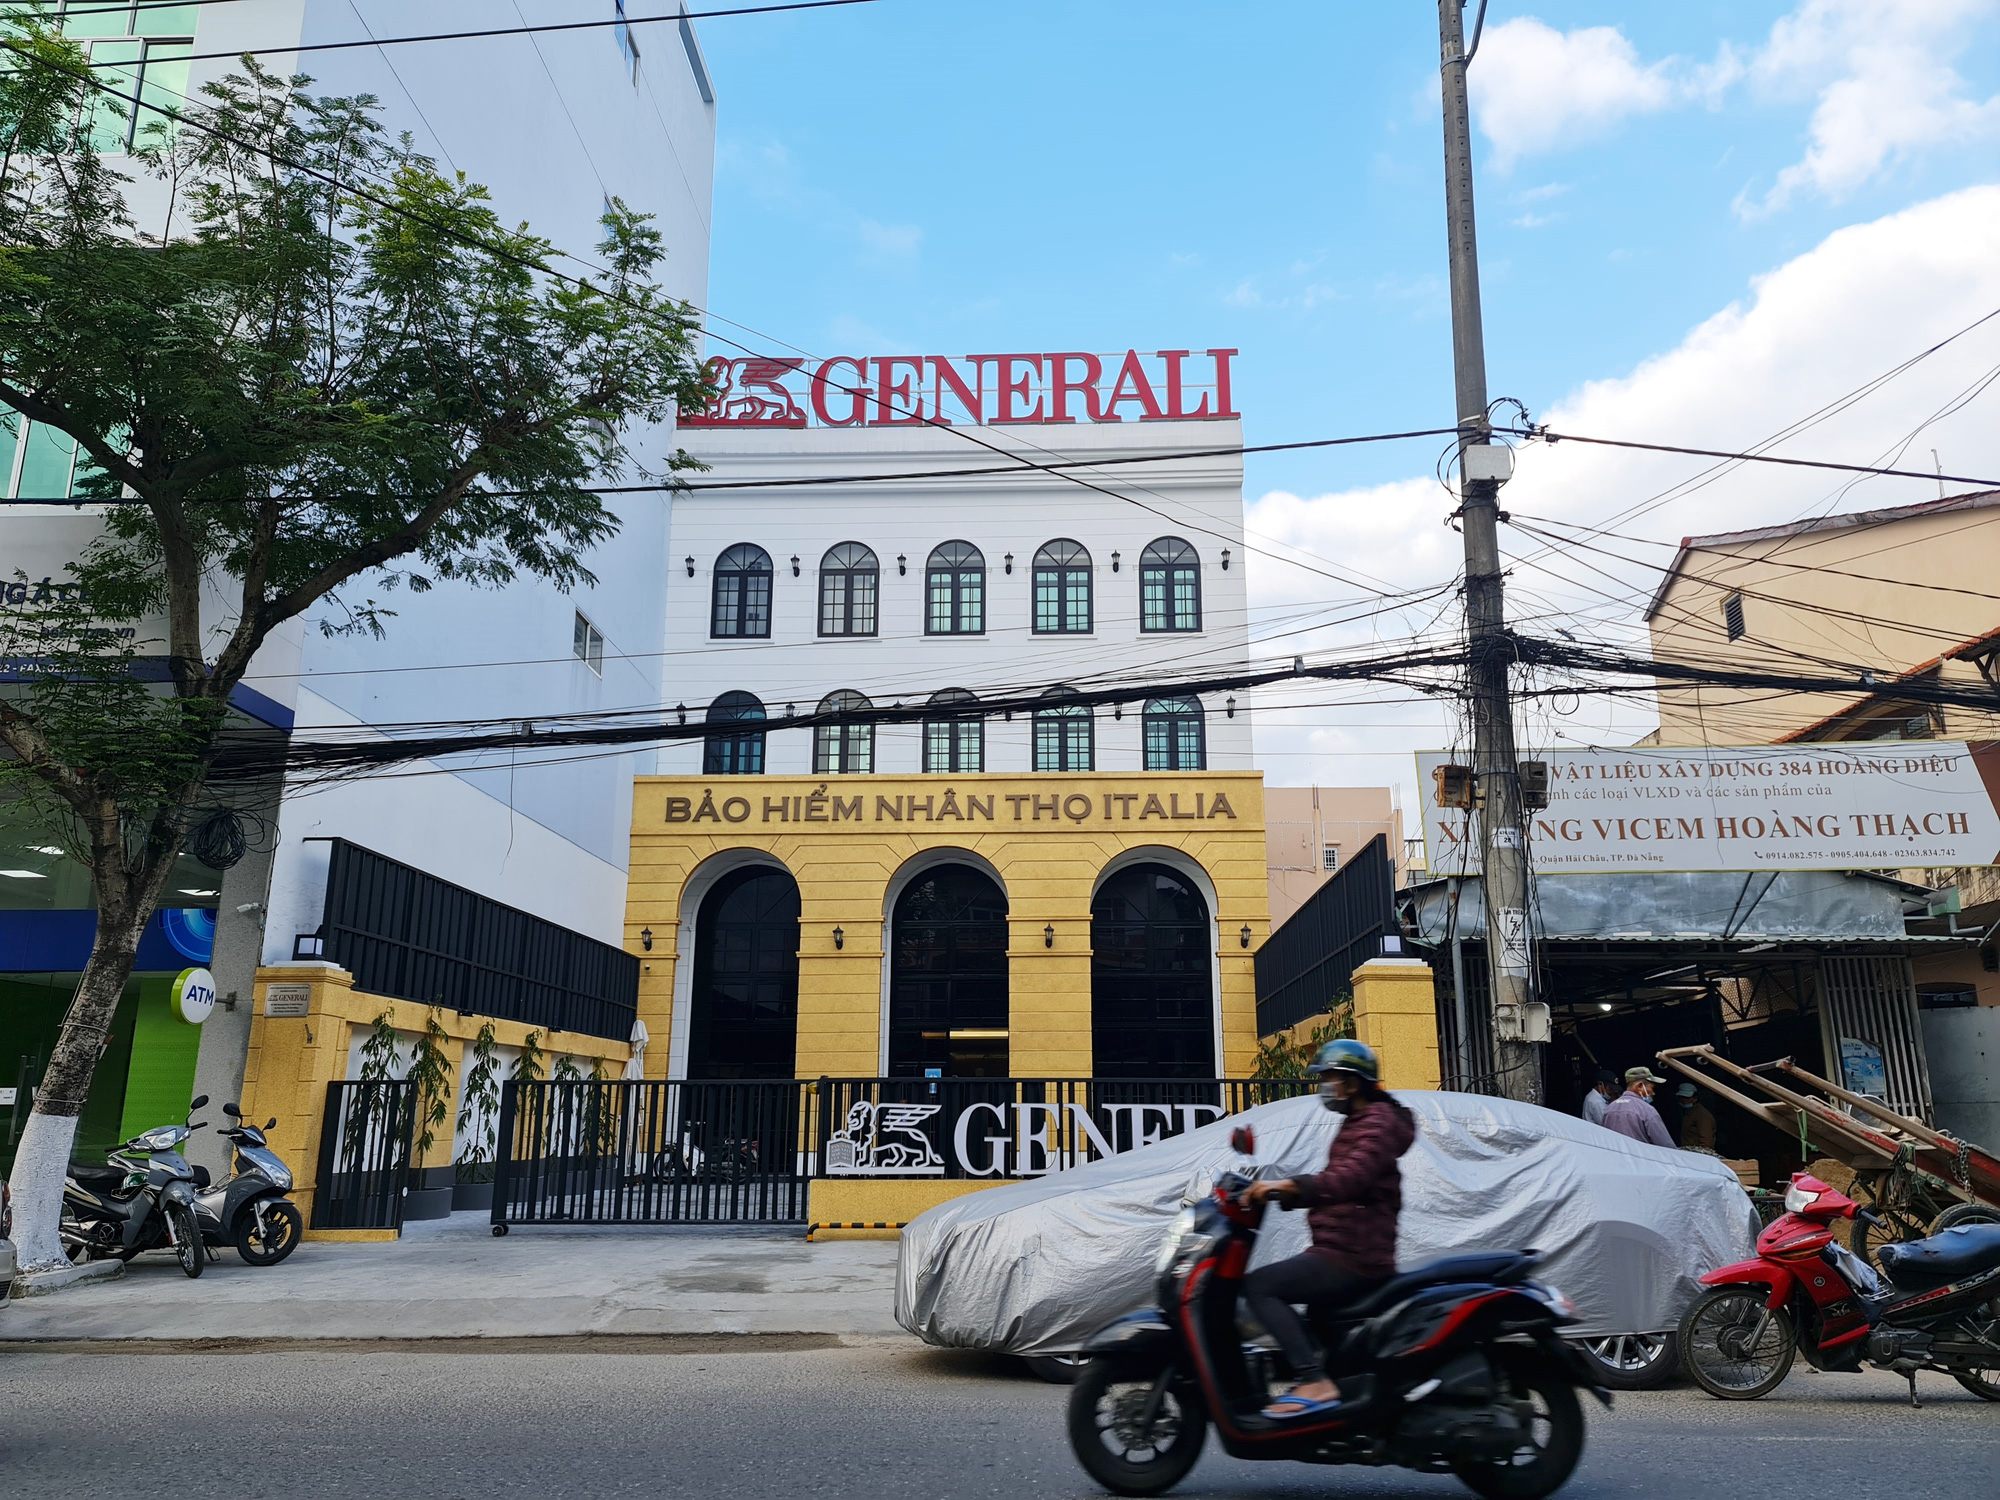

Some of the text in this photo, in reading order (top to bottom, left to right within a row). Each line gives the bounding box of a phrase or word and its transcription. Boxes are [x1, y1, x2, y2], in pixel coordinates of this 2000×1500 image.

[811, 348, 1241, 427] GENERALI
[1550, 754, 1958, 783] VẬT LIỆU XÂY DỰNG 384 HOÀNG DIỆU
[665, 783, 1237, 824] BẢO HIỂM NHÂN THỌ ITALIA
[1574, 788, 1597, 799] các
[1602, 787, 1628, 801] loại
[1633, 786, 1681, 798] VLXD
[1685, 786, 1702, 797] và
[1707, 786, 1730, 797] các
[1735, 785, 1758, 797] sản
[1764, 782, 1802, 799] phẩm
[1807, 784, 1832, 796] của
[1592, 817, 1705, 841] VICEM
[1716, 810, 1840, 839] HOÀNG
[1849, 812, 1971, 841] THẠCH
[1610, 854, 1625, 862] TP.
[1765, 851, 1824, 860] 0914.082.575
[1830, 850, 1888, 859] 0905.404.648
[1894, 849, 1956, 858] 02363.834.742
[186, 985, 214, 1006] ATM
